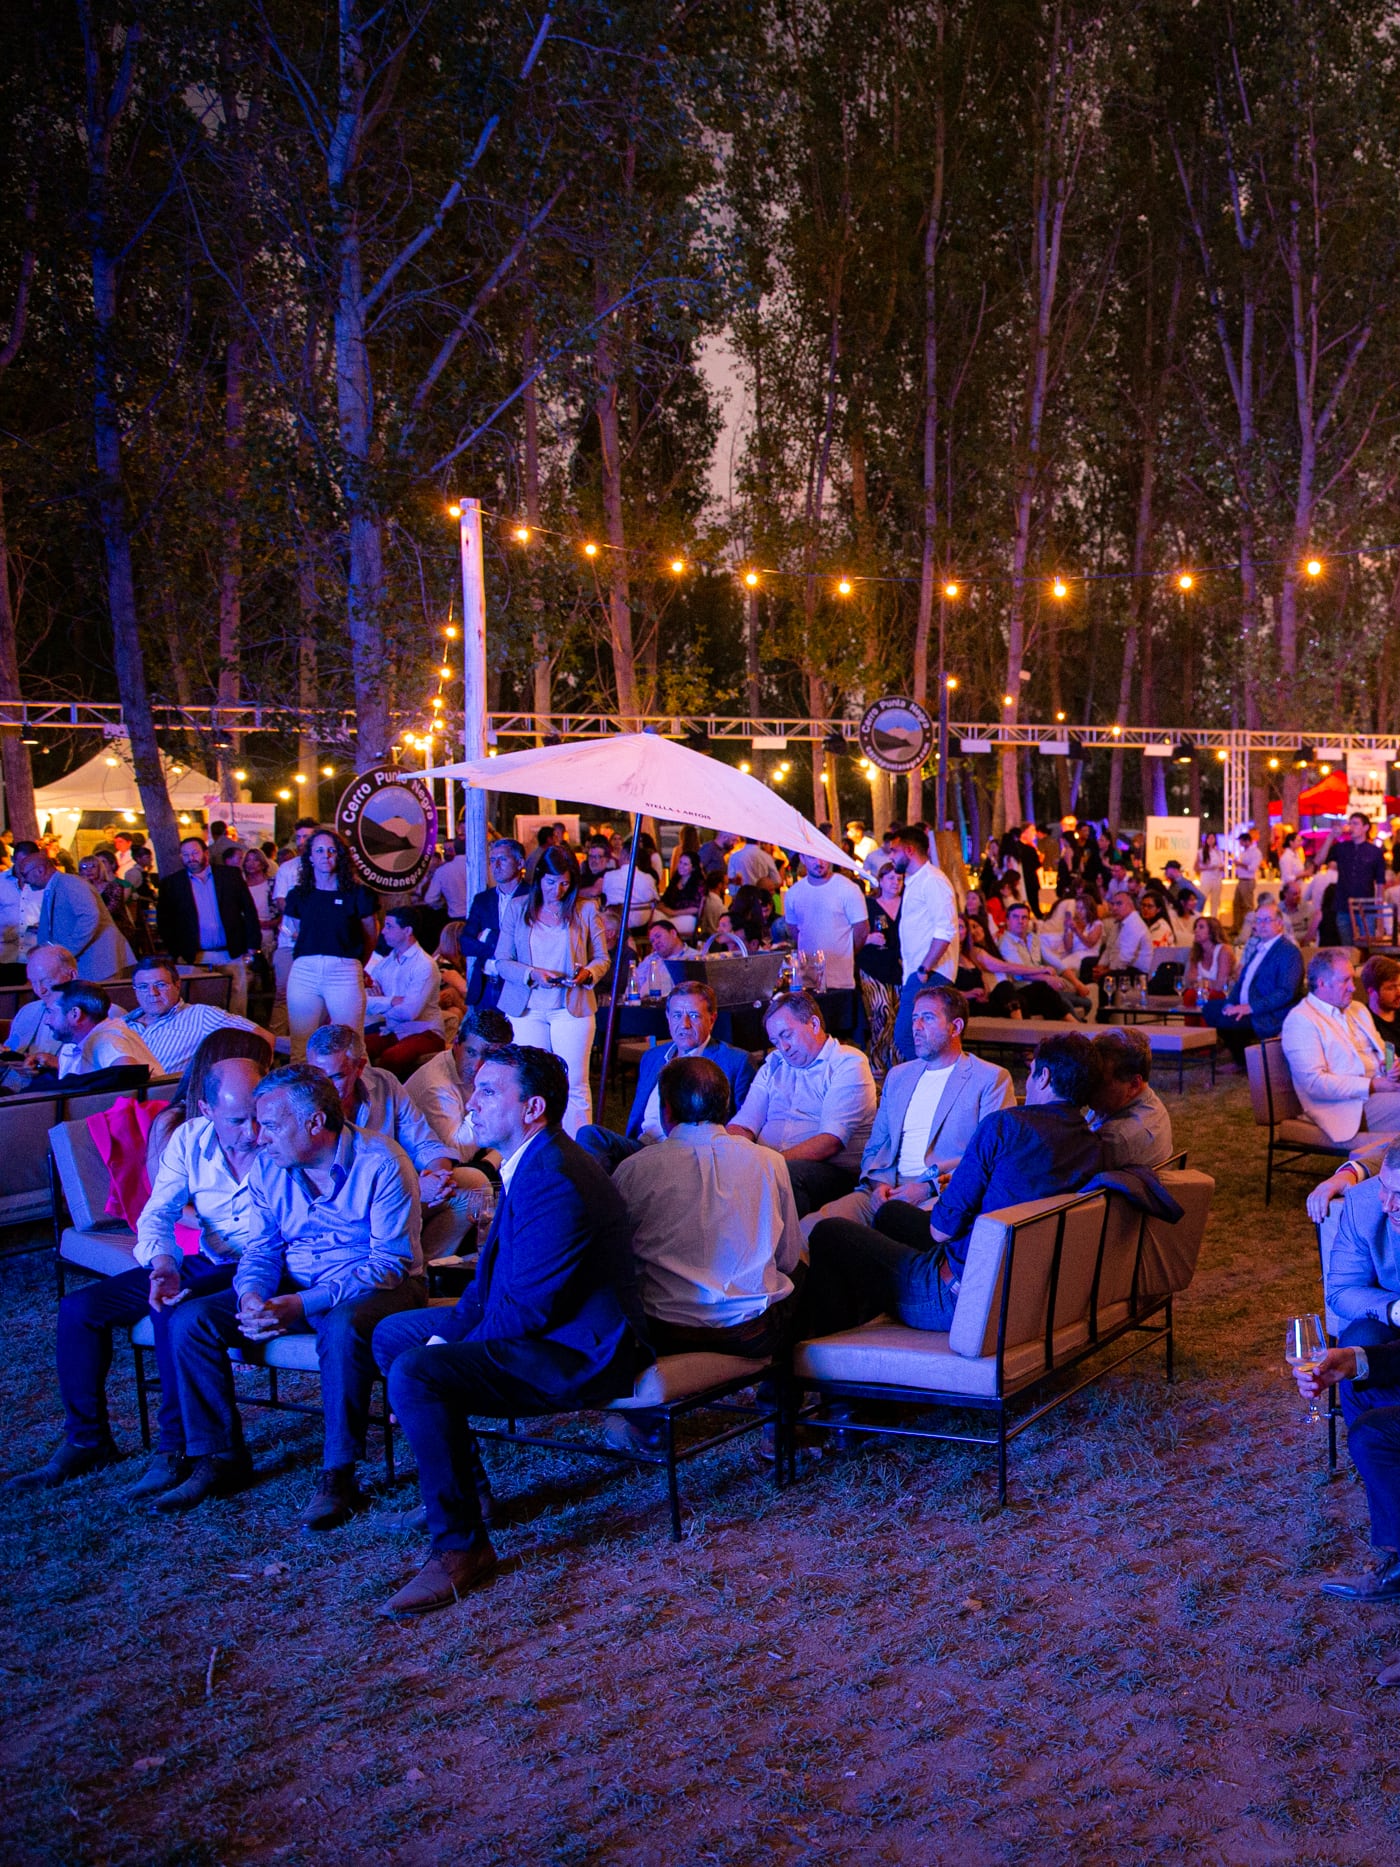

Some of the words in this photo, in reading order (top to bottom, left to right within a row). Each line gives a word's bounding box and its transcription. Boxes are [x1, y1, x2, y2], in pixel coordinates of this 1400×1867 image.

[861, 708, 879, 734] Cerro
[879, 698, 906, 710] Punta
[342, 783, 371, 823] Cerro
[374, 771, 408, 786] Pun
[645, 802, 674, 812] STELLA
[683, 810, 711, 820] ARTOIS
[349, 844, 433, 888] cerropuntanegra.com
